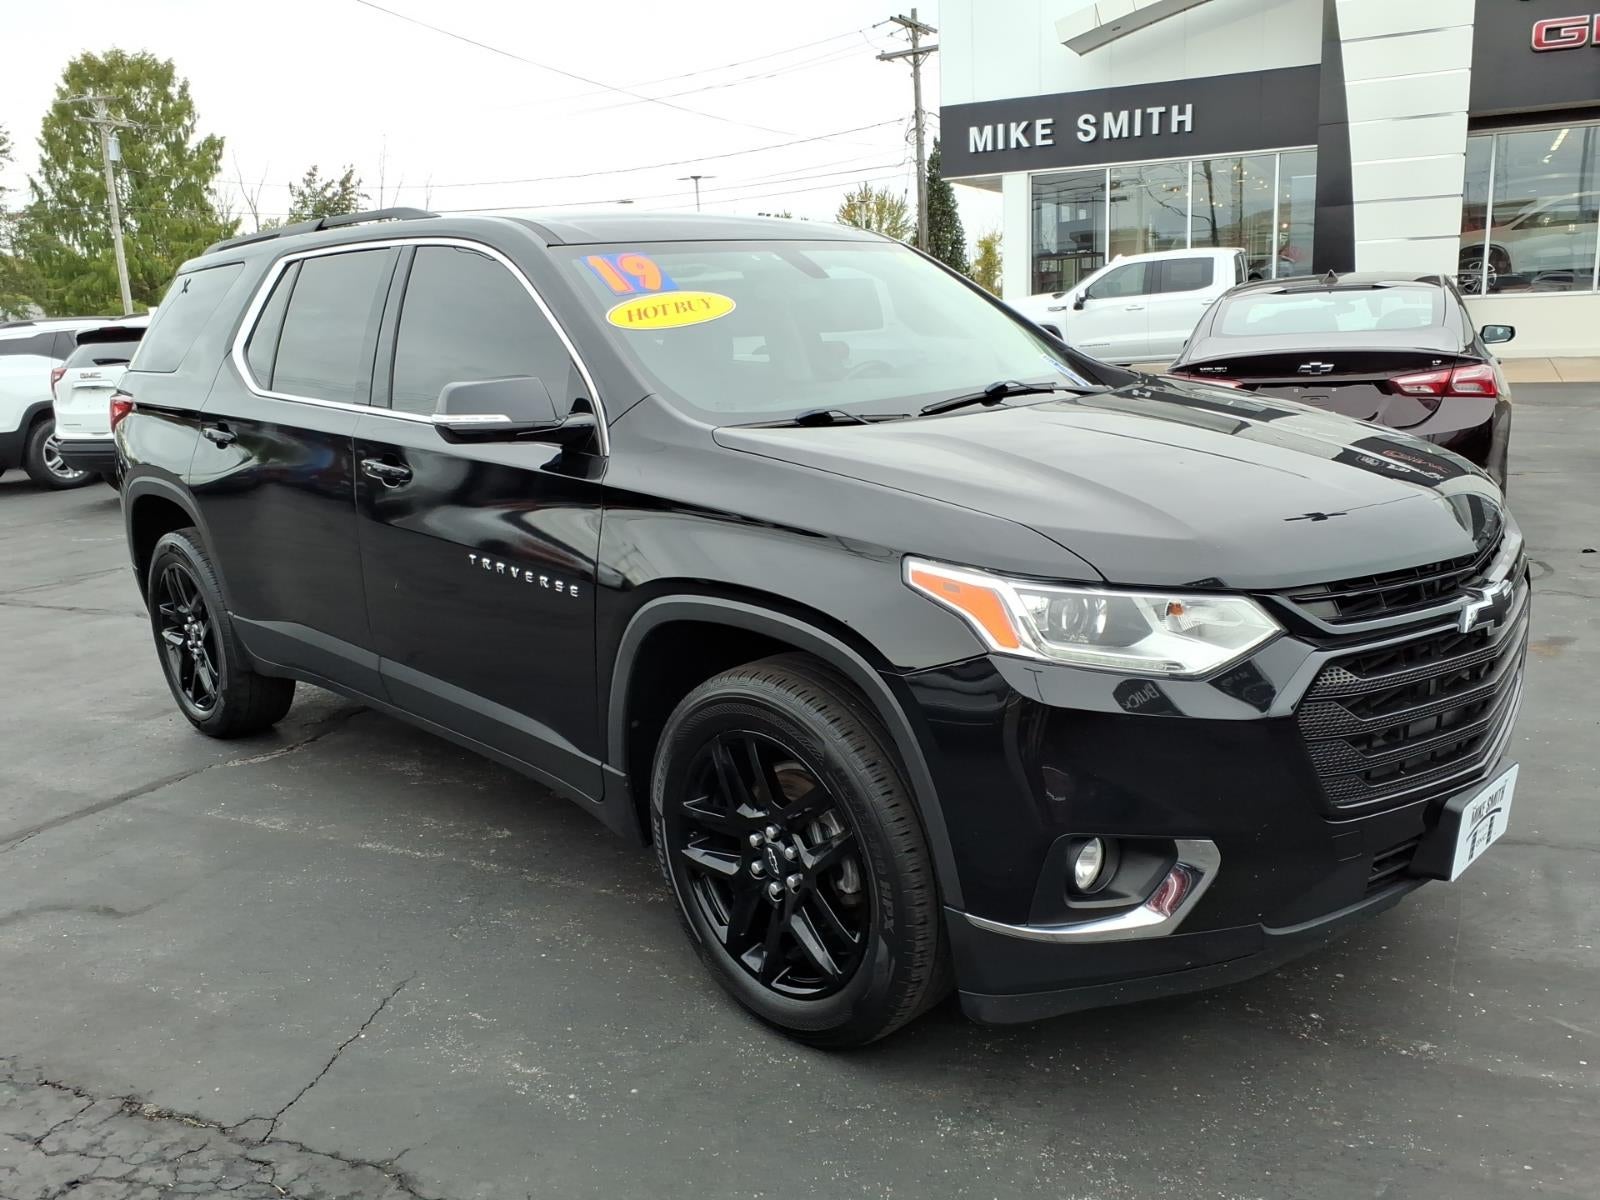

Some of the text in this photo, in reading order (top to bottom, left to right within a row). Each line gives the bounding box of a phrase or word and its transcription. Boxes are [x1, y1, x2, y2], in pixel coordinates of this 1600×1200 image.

[969, 104, 1193, 153] MIKE SMITH
[587, 253, 662, 292] 19
[627, 298, 711, 323] HOT BUY
[468, 553, 579, 598] TRAVERSE
